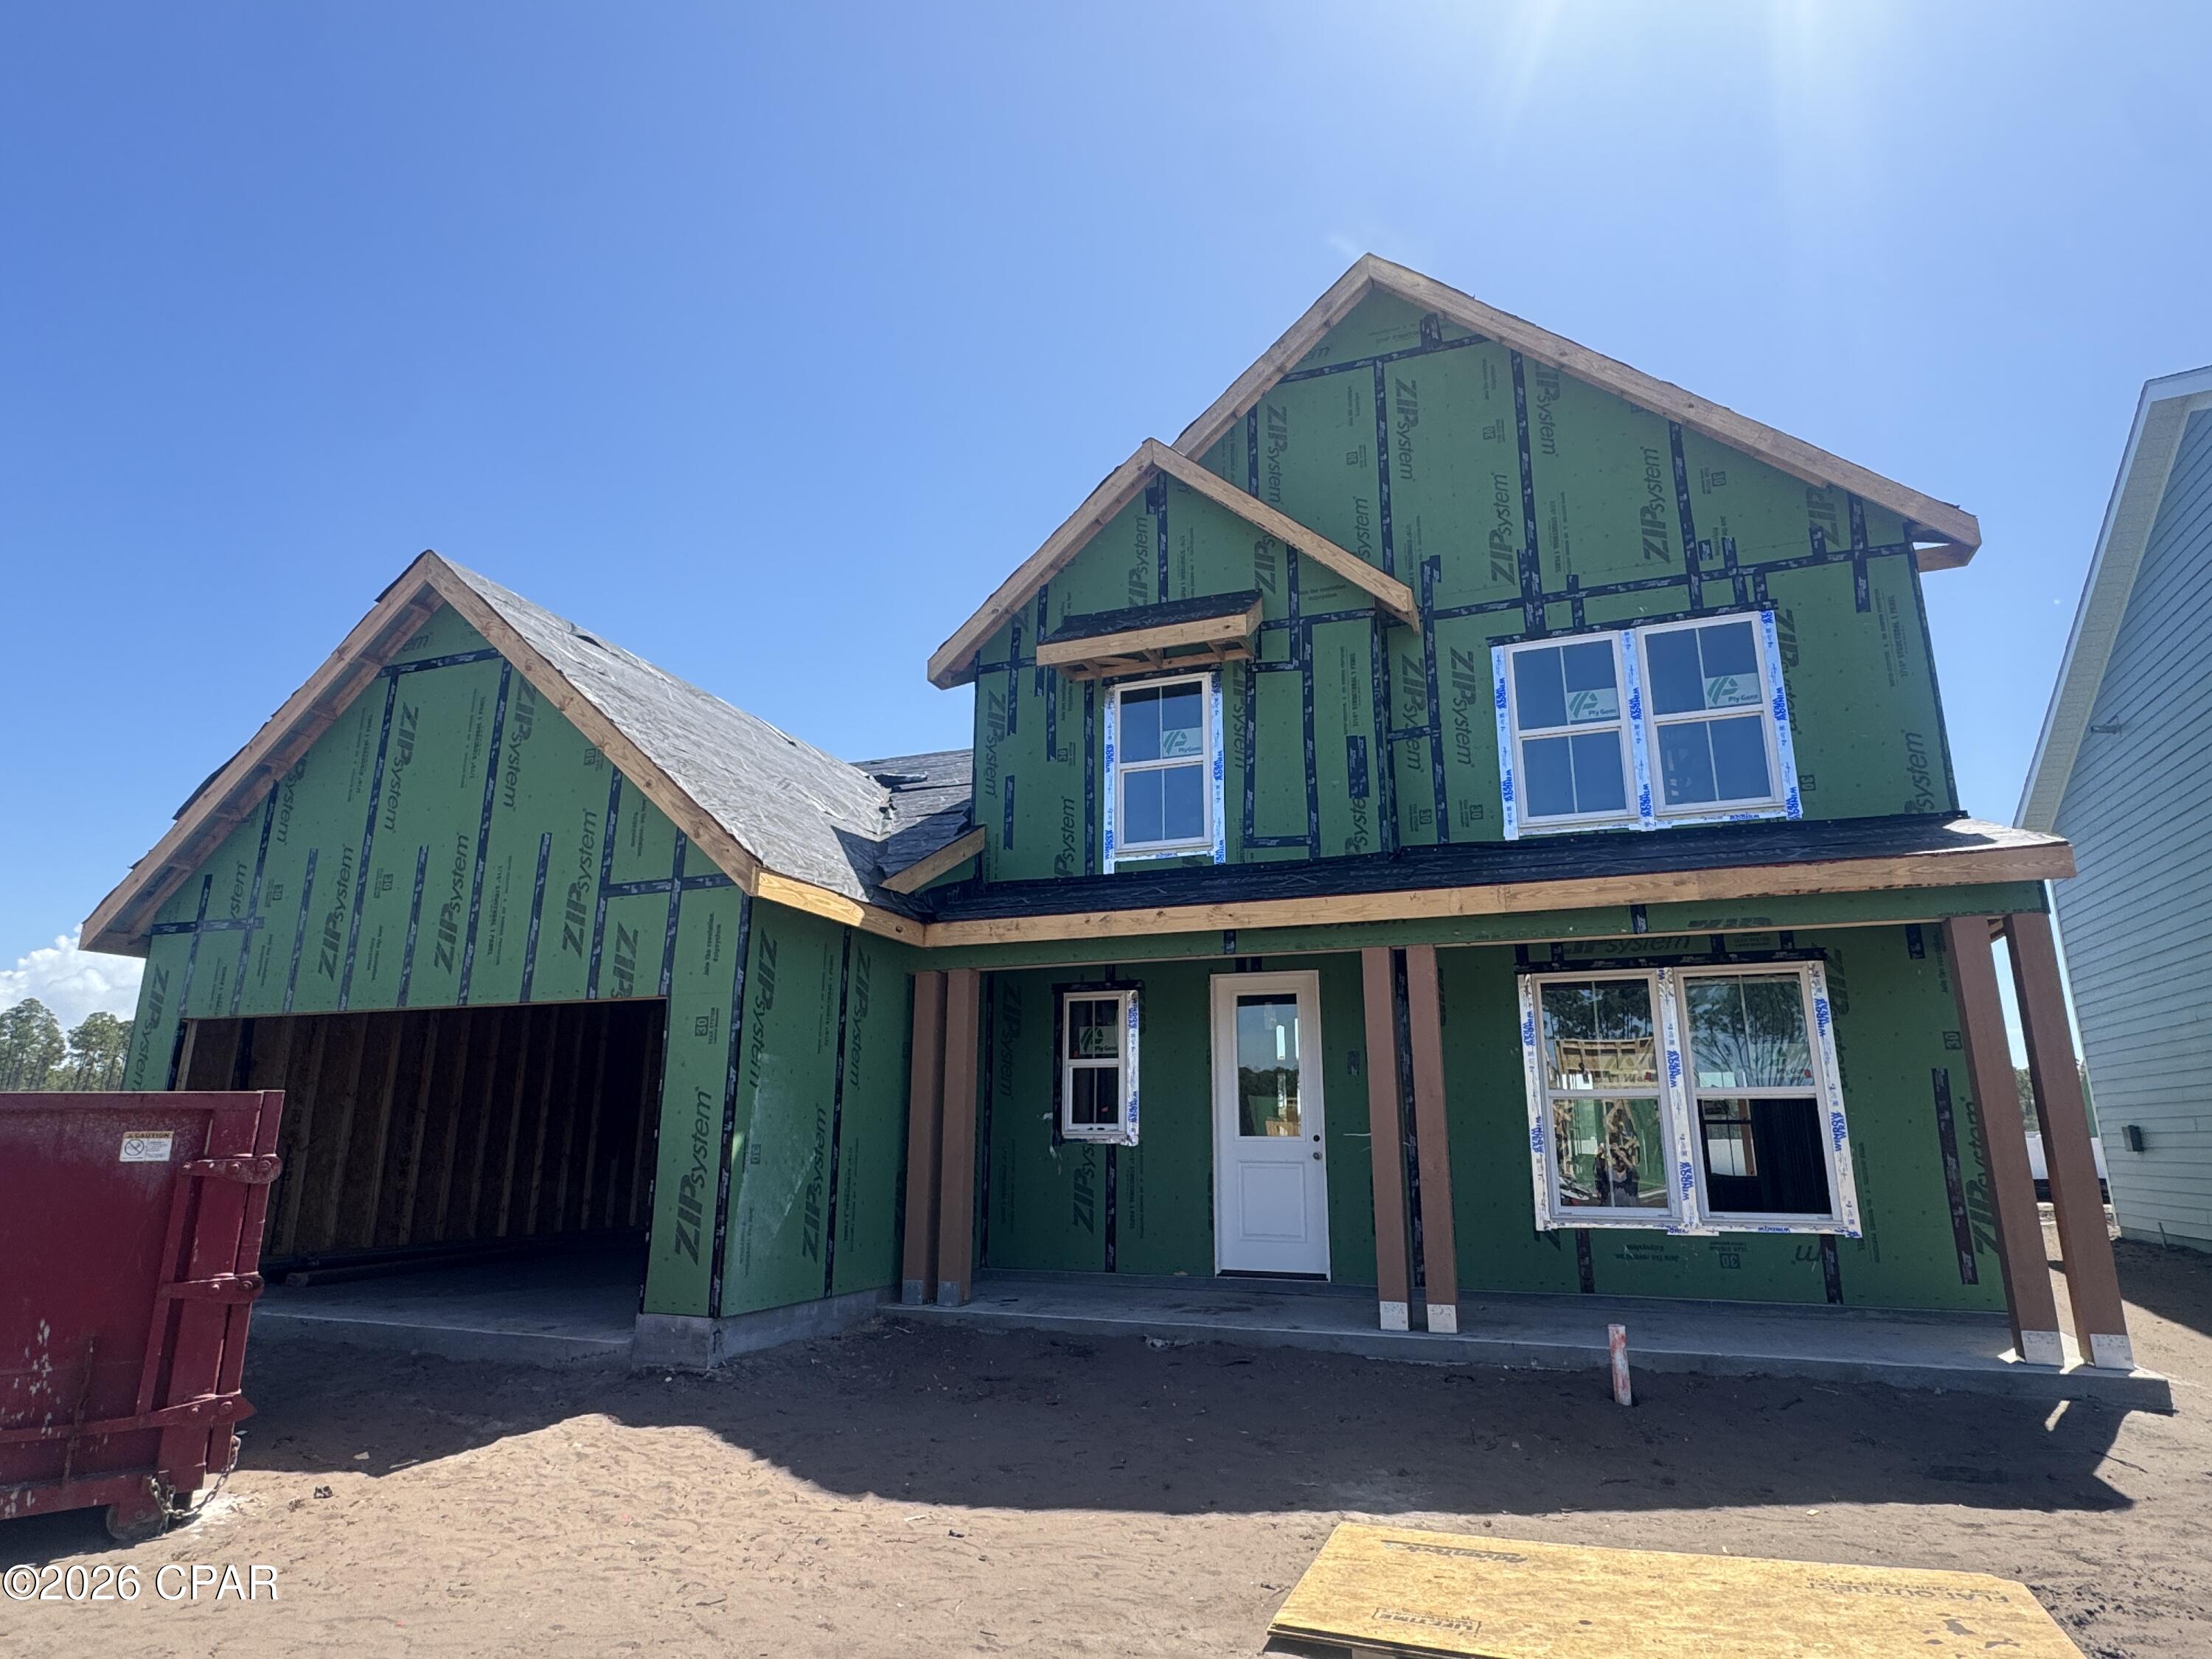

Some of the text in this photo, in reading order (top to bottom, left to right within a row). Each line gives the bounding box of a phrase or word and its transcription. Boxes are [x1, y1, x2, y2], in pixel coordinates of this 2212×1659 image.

[1776, 687, 1787, 720] WINDOW
[1526, 1011, 1534, 1046] WINDOW
[1815, 998, 1826, 1037] WINDOW
[1667, 1050, 1678, 1088] WINDOW
[1535, 1116, 1544, 1153] WINDOW
[1831, 1112, 1842, 1152] WINDOW
[1680, 1162, 1690, 1200] WINDOW
[1882, 1587, 1935, 1598] OUT
[1944, 1592, 2009, 1604] FLAT
